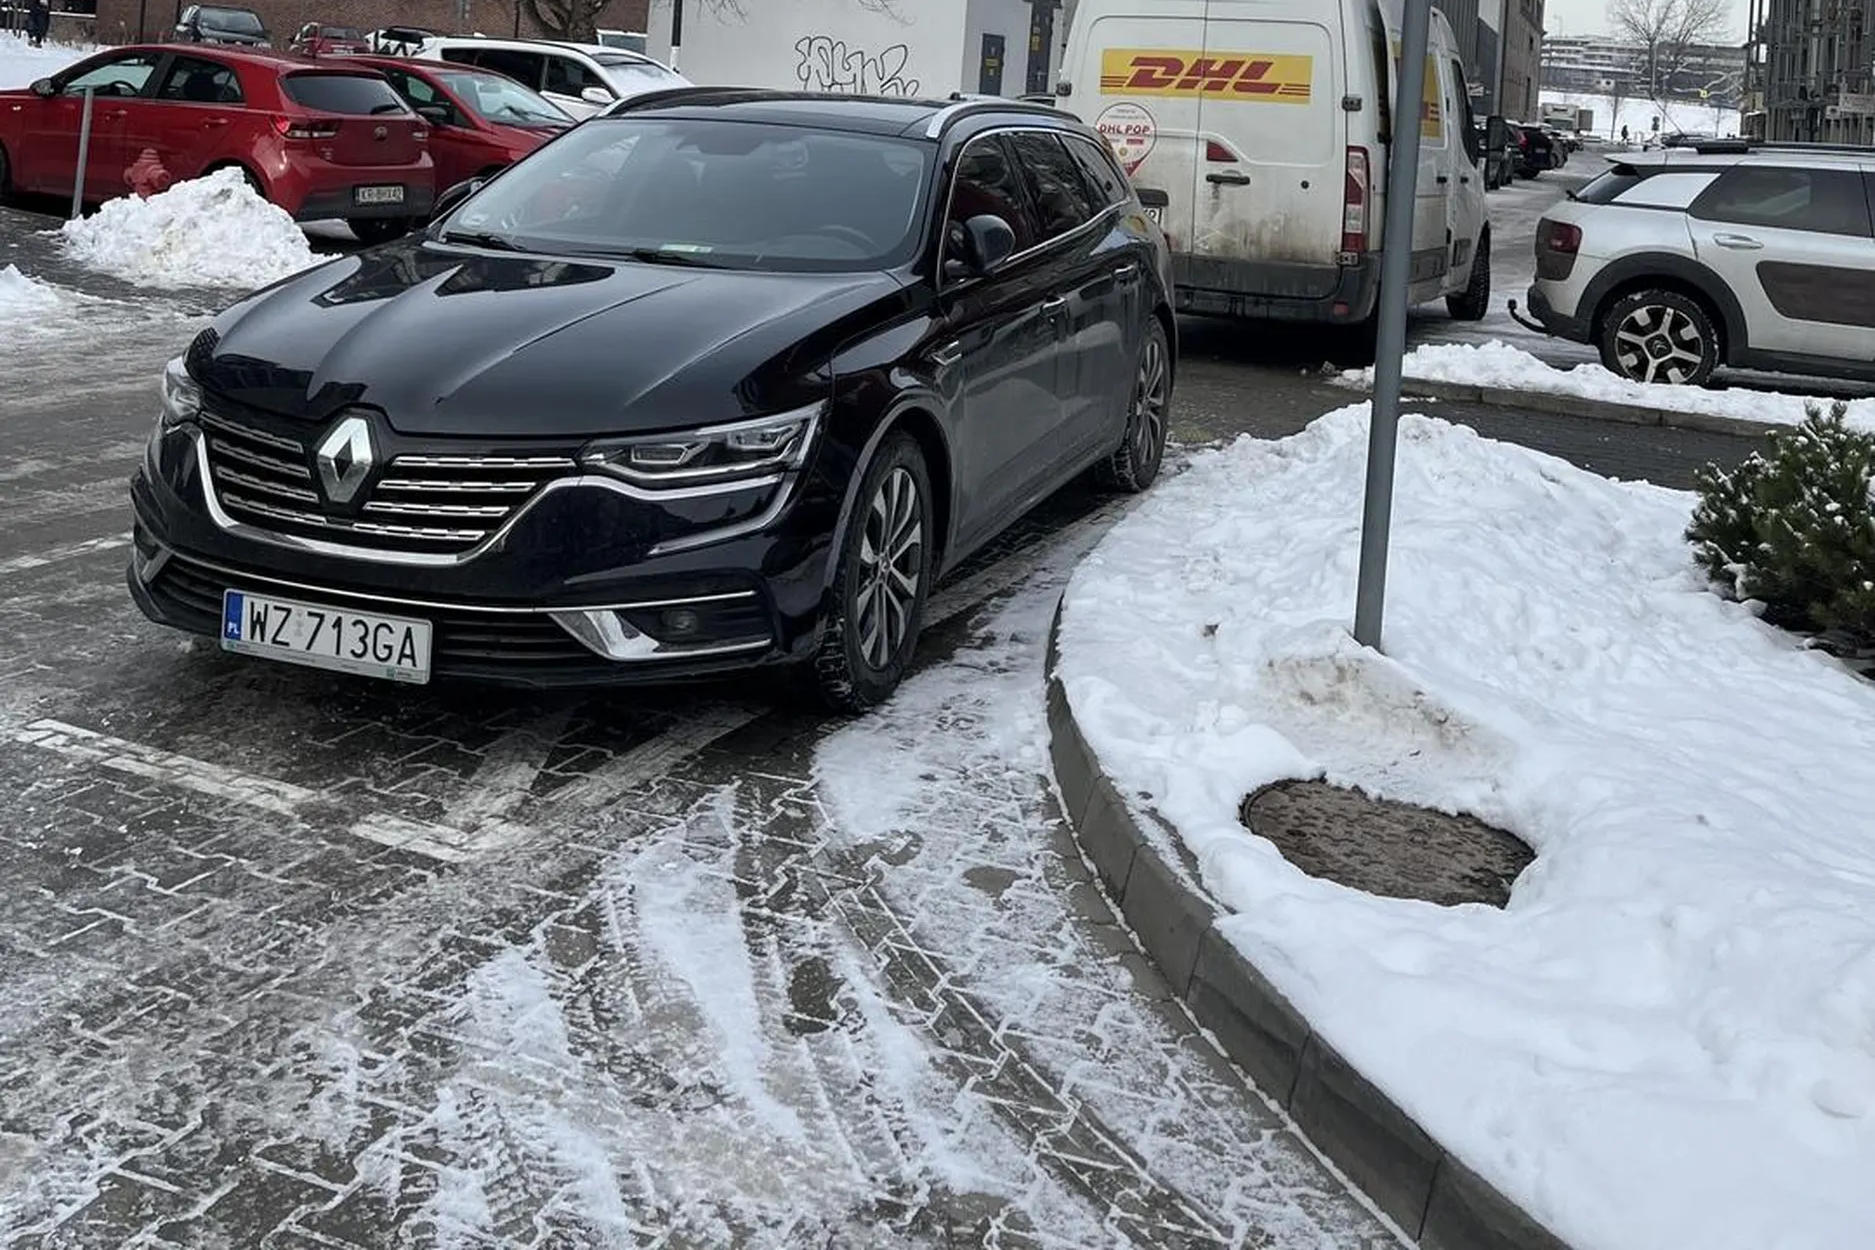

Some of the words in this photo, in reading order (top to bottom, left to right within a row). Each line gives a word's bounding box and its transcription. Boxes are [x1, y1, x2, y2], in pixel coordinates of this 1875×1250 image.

[1126, 56, 1282, 94] DHL
[1099, 123, 1123, 135] DHL
[1125, 124, 1151, 135] POP
[227, 621, 239, 635] PL
[250, 601, 292, 647] WZ
[305, 611, 417, 668] 713GA
